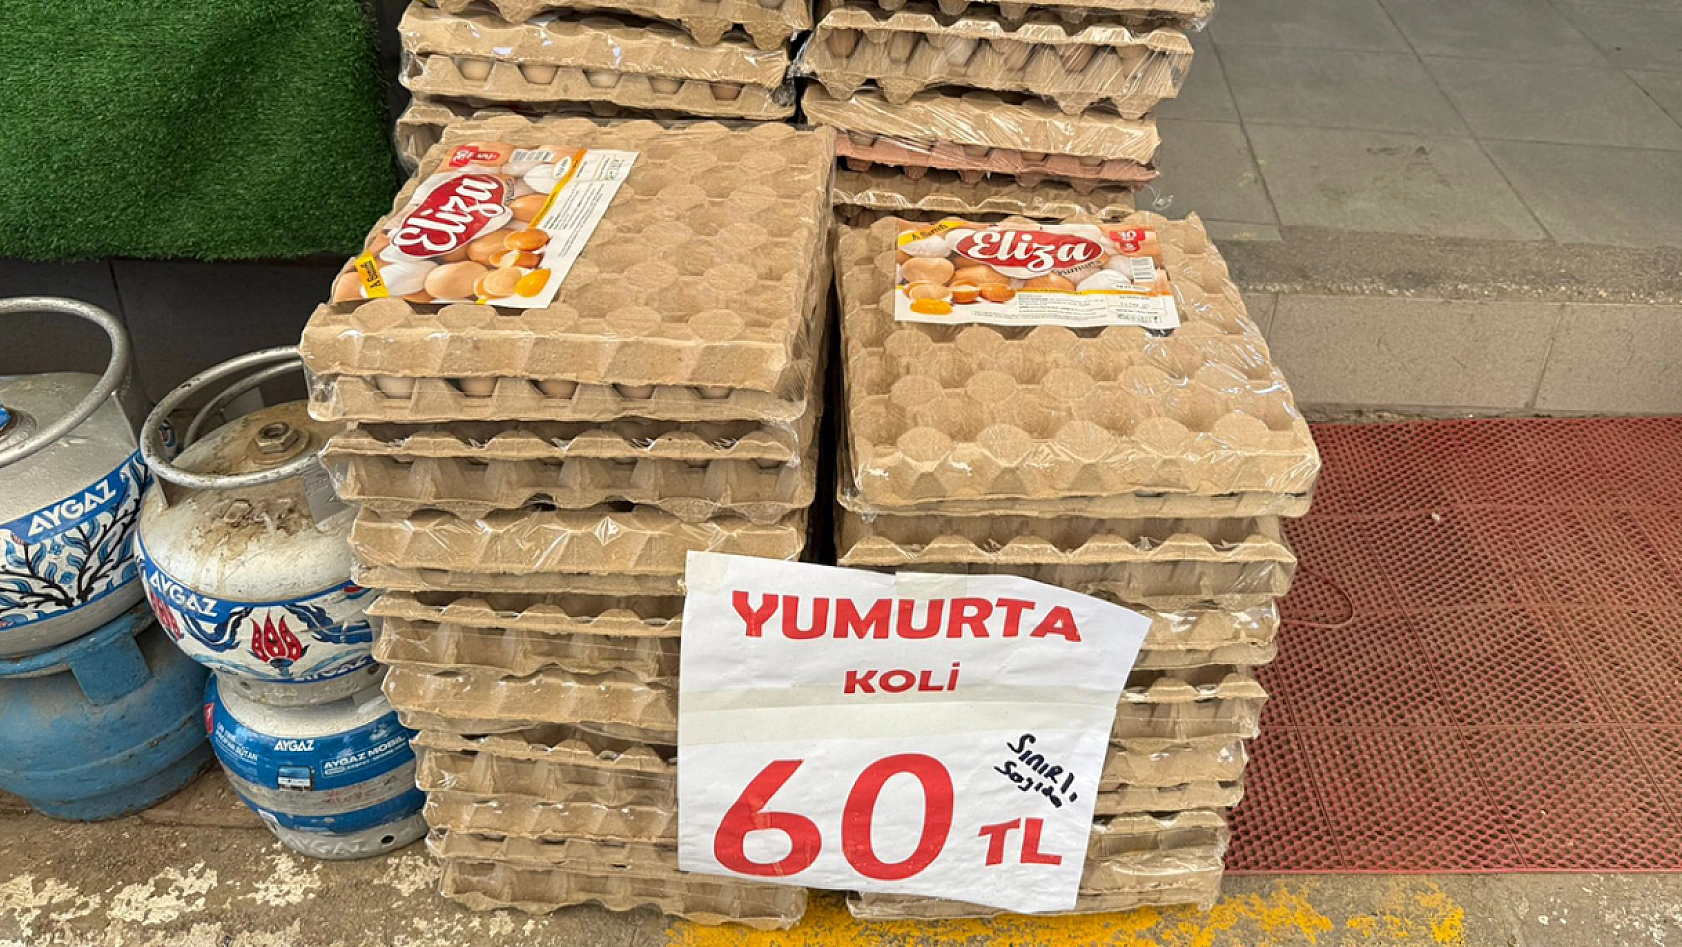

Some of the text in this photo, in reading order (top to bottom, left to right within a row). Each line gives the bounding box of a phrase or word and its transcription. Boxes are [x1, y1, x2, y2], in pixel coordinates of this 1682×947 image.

[394, 178, 504, 251] Eliza
[967, 231, 1094, 271] Eliza
[28, 479, 117, 537] AYGAZ
[150, 570, 218, 617] AYGAZ
[732, 590, 1082, 643] YUMURTA
[844, 662, 960, 695] KOLİ
[273, 739, 315, 752] AYGAZ
[324, 752, 367, 770] AYGAZ
[713, 753, 1063, 882] 60 TL
